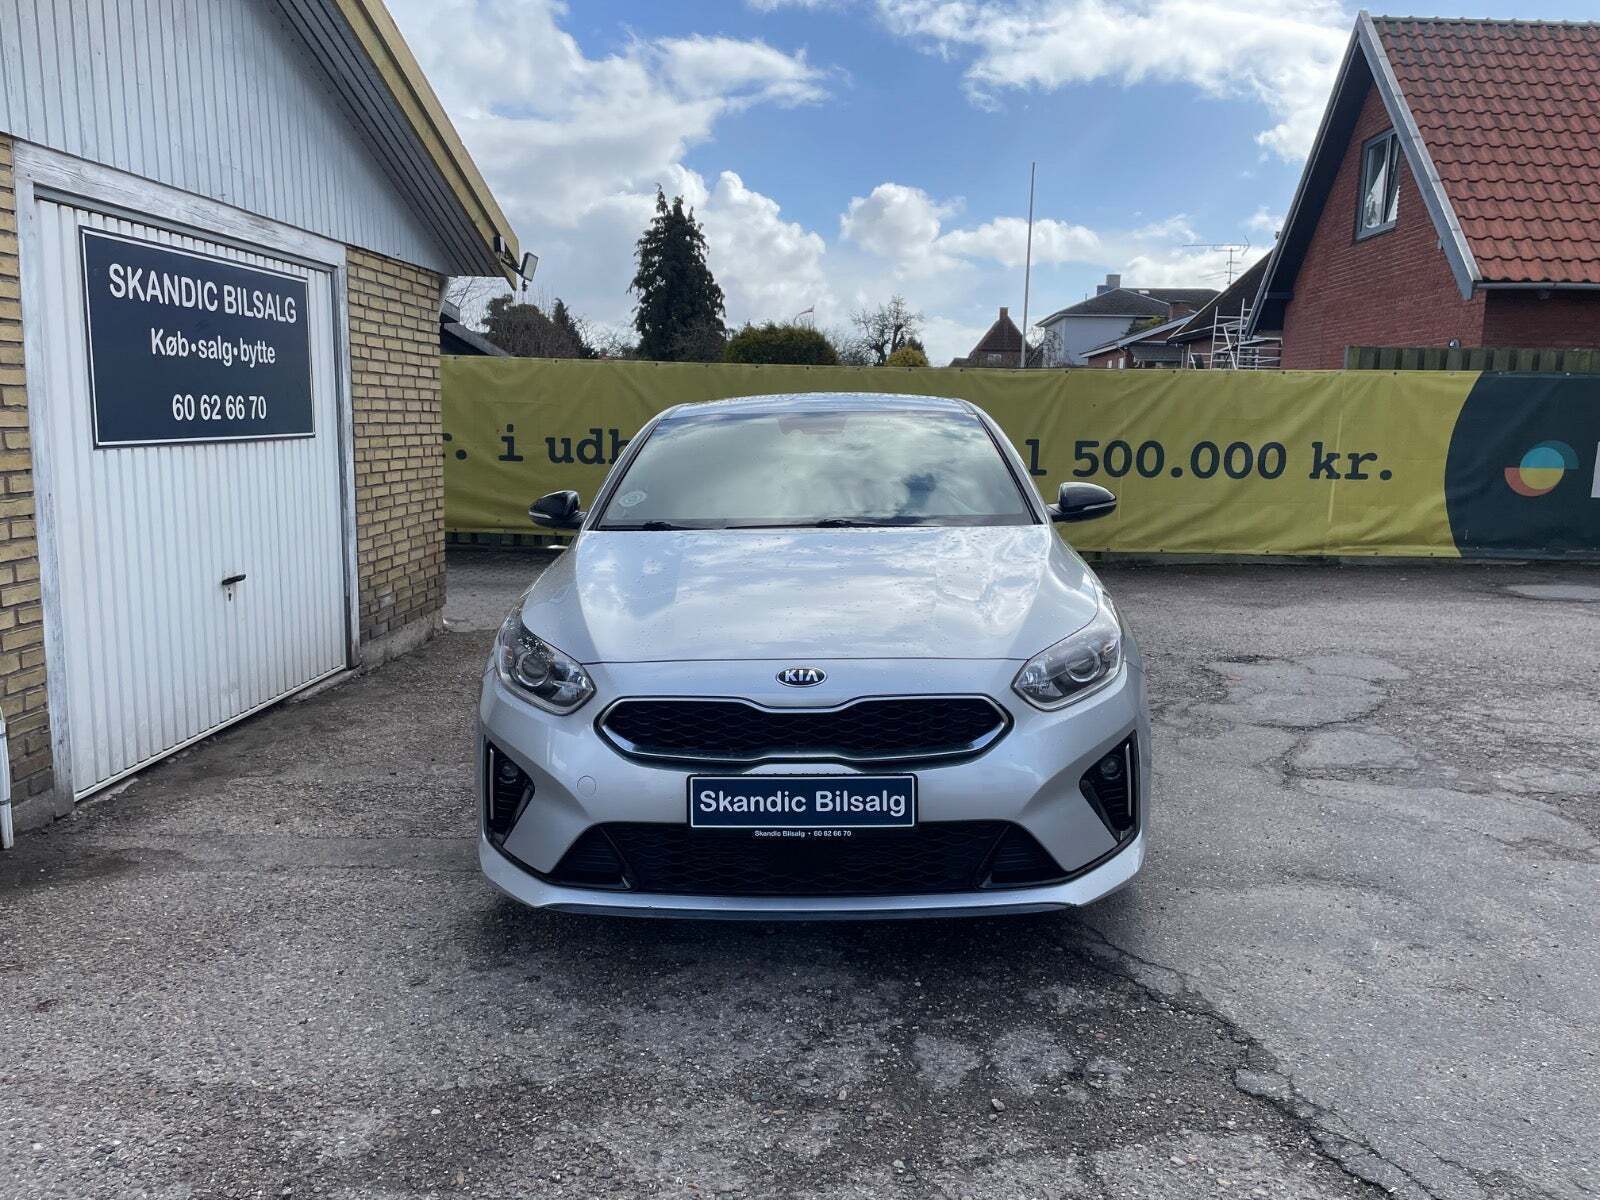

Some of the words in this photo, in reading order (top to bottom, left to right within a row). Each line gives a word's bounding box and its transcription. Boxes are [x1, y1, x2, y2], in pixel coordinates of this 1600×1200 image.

[109, 263, 218, 312] SKANDIC
[223, 284, 297, 324] BILSALG
[172, 394, 195, 421] 60
[200, 395, 222, 420] 62
[225, 395, 245, 420] 66
[248, 395, 267, 420] 70
[498, 423, 524, 462] i
[1072, 439, 1287, 480] 500.000
[1308, 442, 1392, 481] kr.
[784, 669, 819, 682] KIA
[699, 790, 807, 813] Skandic
[815, 790, 905, 817] Bilsalg
[782, 830, 805, 838] Bilsalg
